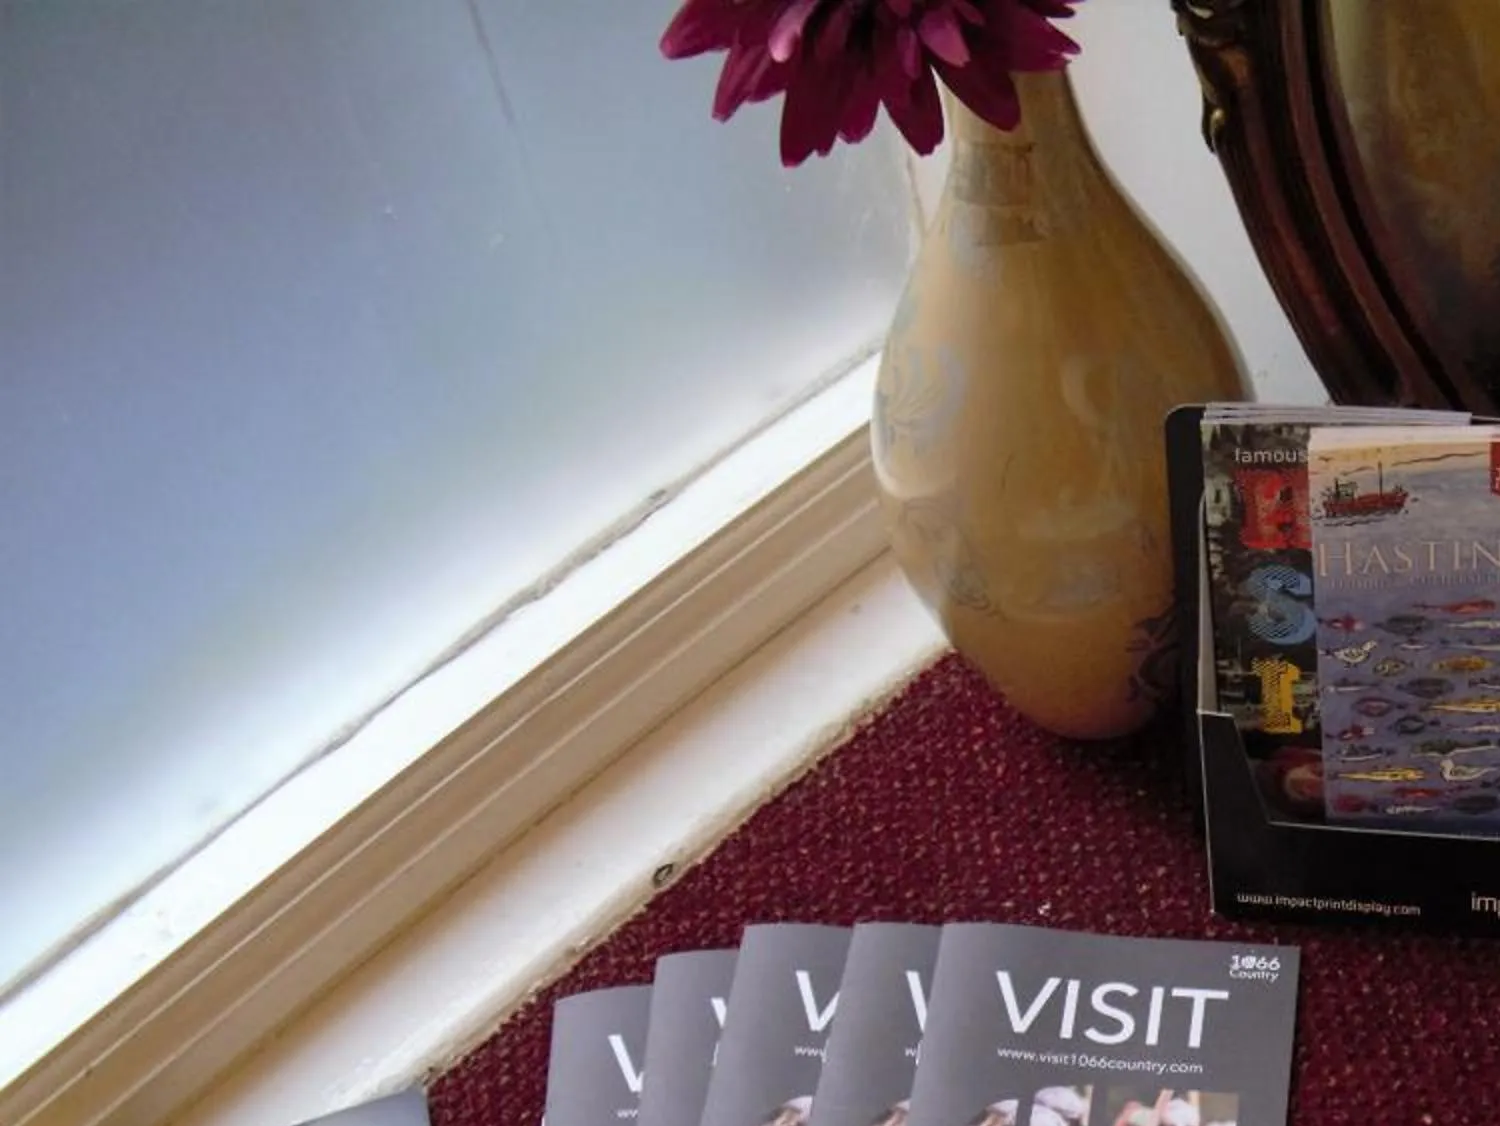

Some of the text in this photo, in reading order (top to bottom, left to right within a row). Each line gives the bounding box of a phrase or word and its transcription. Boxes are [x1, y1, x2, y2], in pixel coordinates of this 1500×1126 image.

[1229, 953, 1281, 970] 1066
[1229, 967, 1280, 984] Country
[995, 970, 1230, 1049] VISIT
[996, 1047, 1204, 1075] www.visit1066country.com
